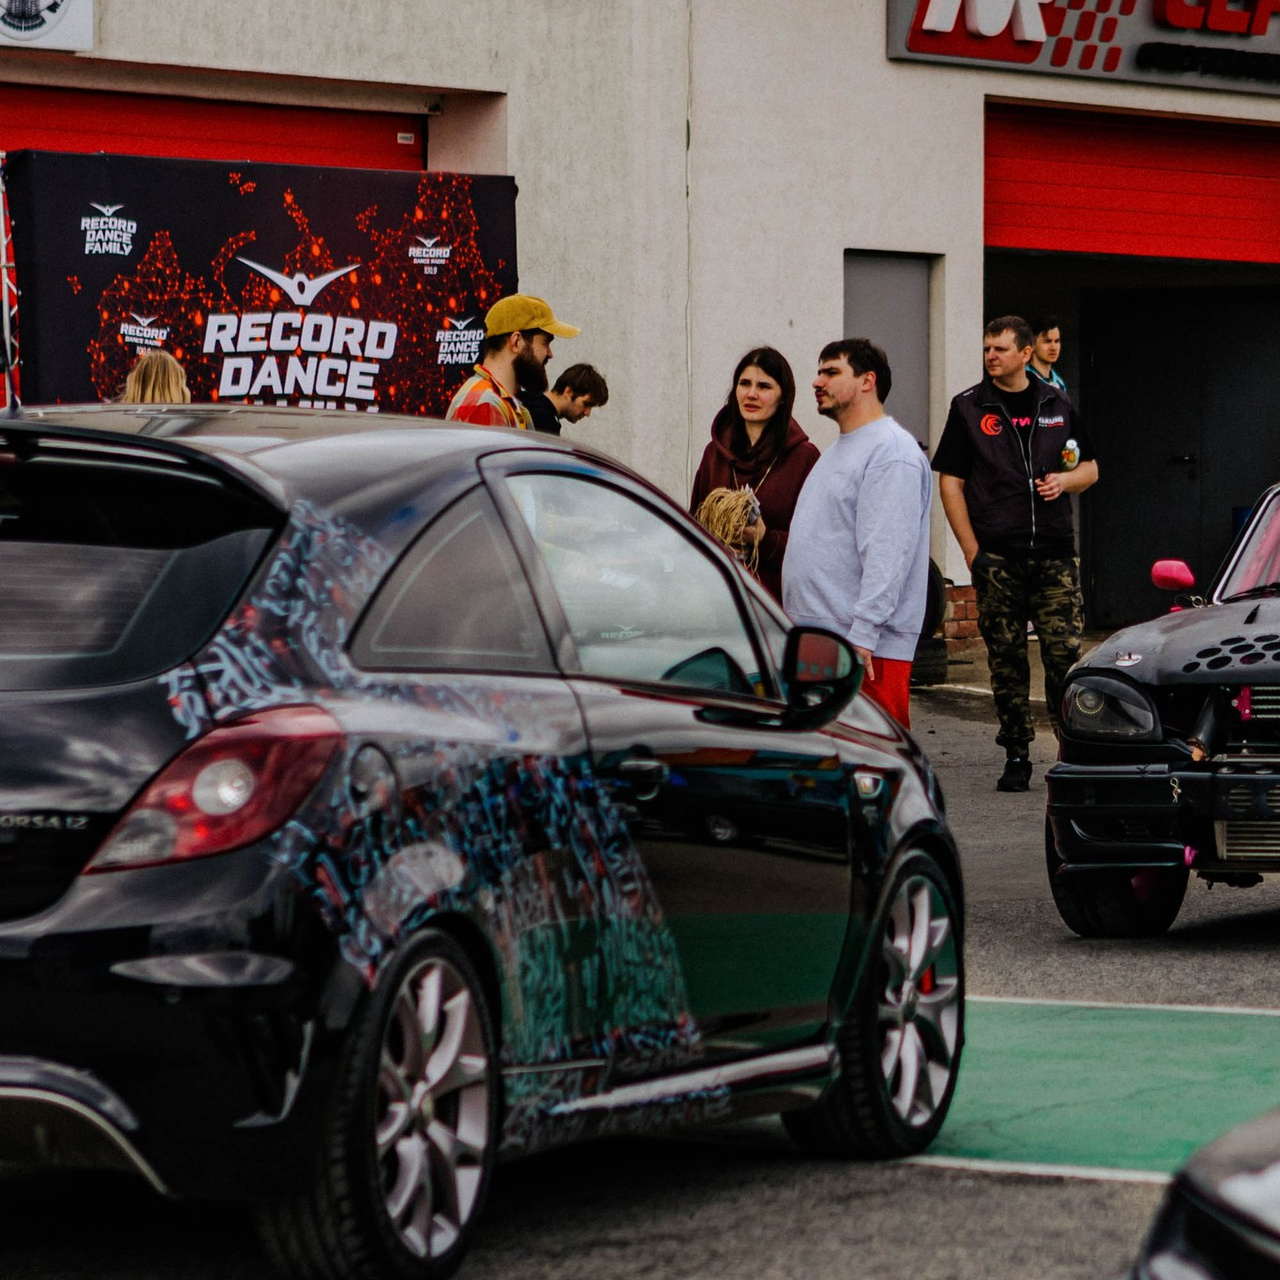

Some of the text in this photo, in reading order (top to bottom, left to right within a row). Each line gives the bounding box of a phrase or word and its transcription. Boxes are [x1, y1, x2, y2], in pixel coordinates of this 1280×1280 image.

[81, 216, 137, 234] RECORD
[86, 230, 132, 245] DANCE
[84, 243, 132, 256] FAMILY
[408, 246, 450, 258] RECORD
[120, 323, 168, 340] RECORD
[203, 312, 398, 360] RECORD
[436, 330, 484, 343] RECORD
[439, 342, 480, 353] DANCE
[437, 353, 479, 365] FAMILY
[219, 356, 380, 400] DANCE
